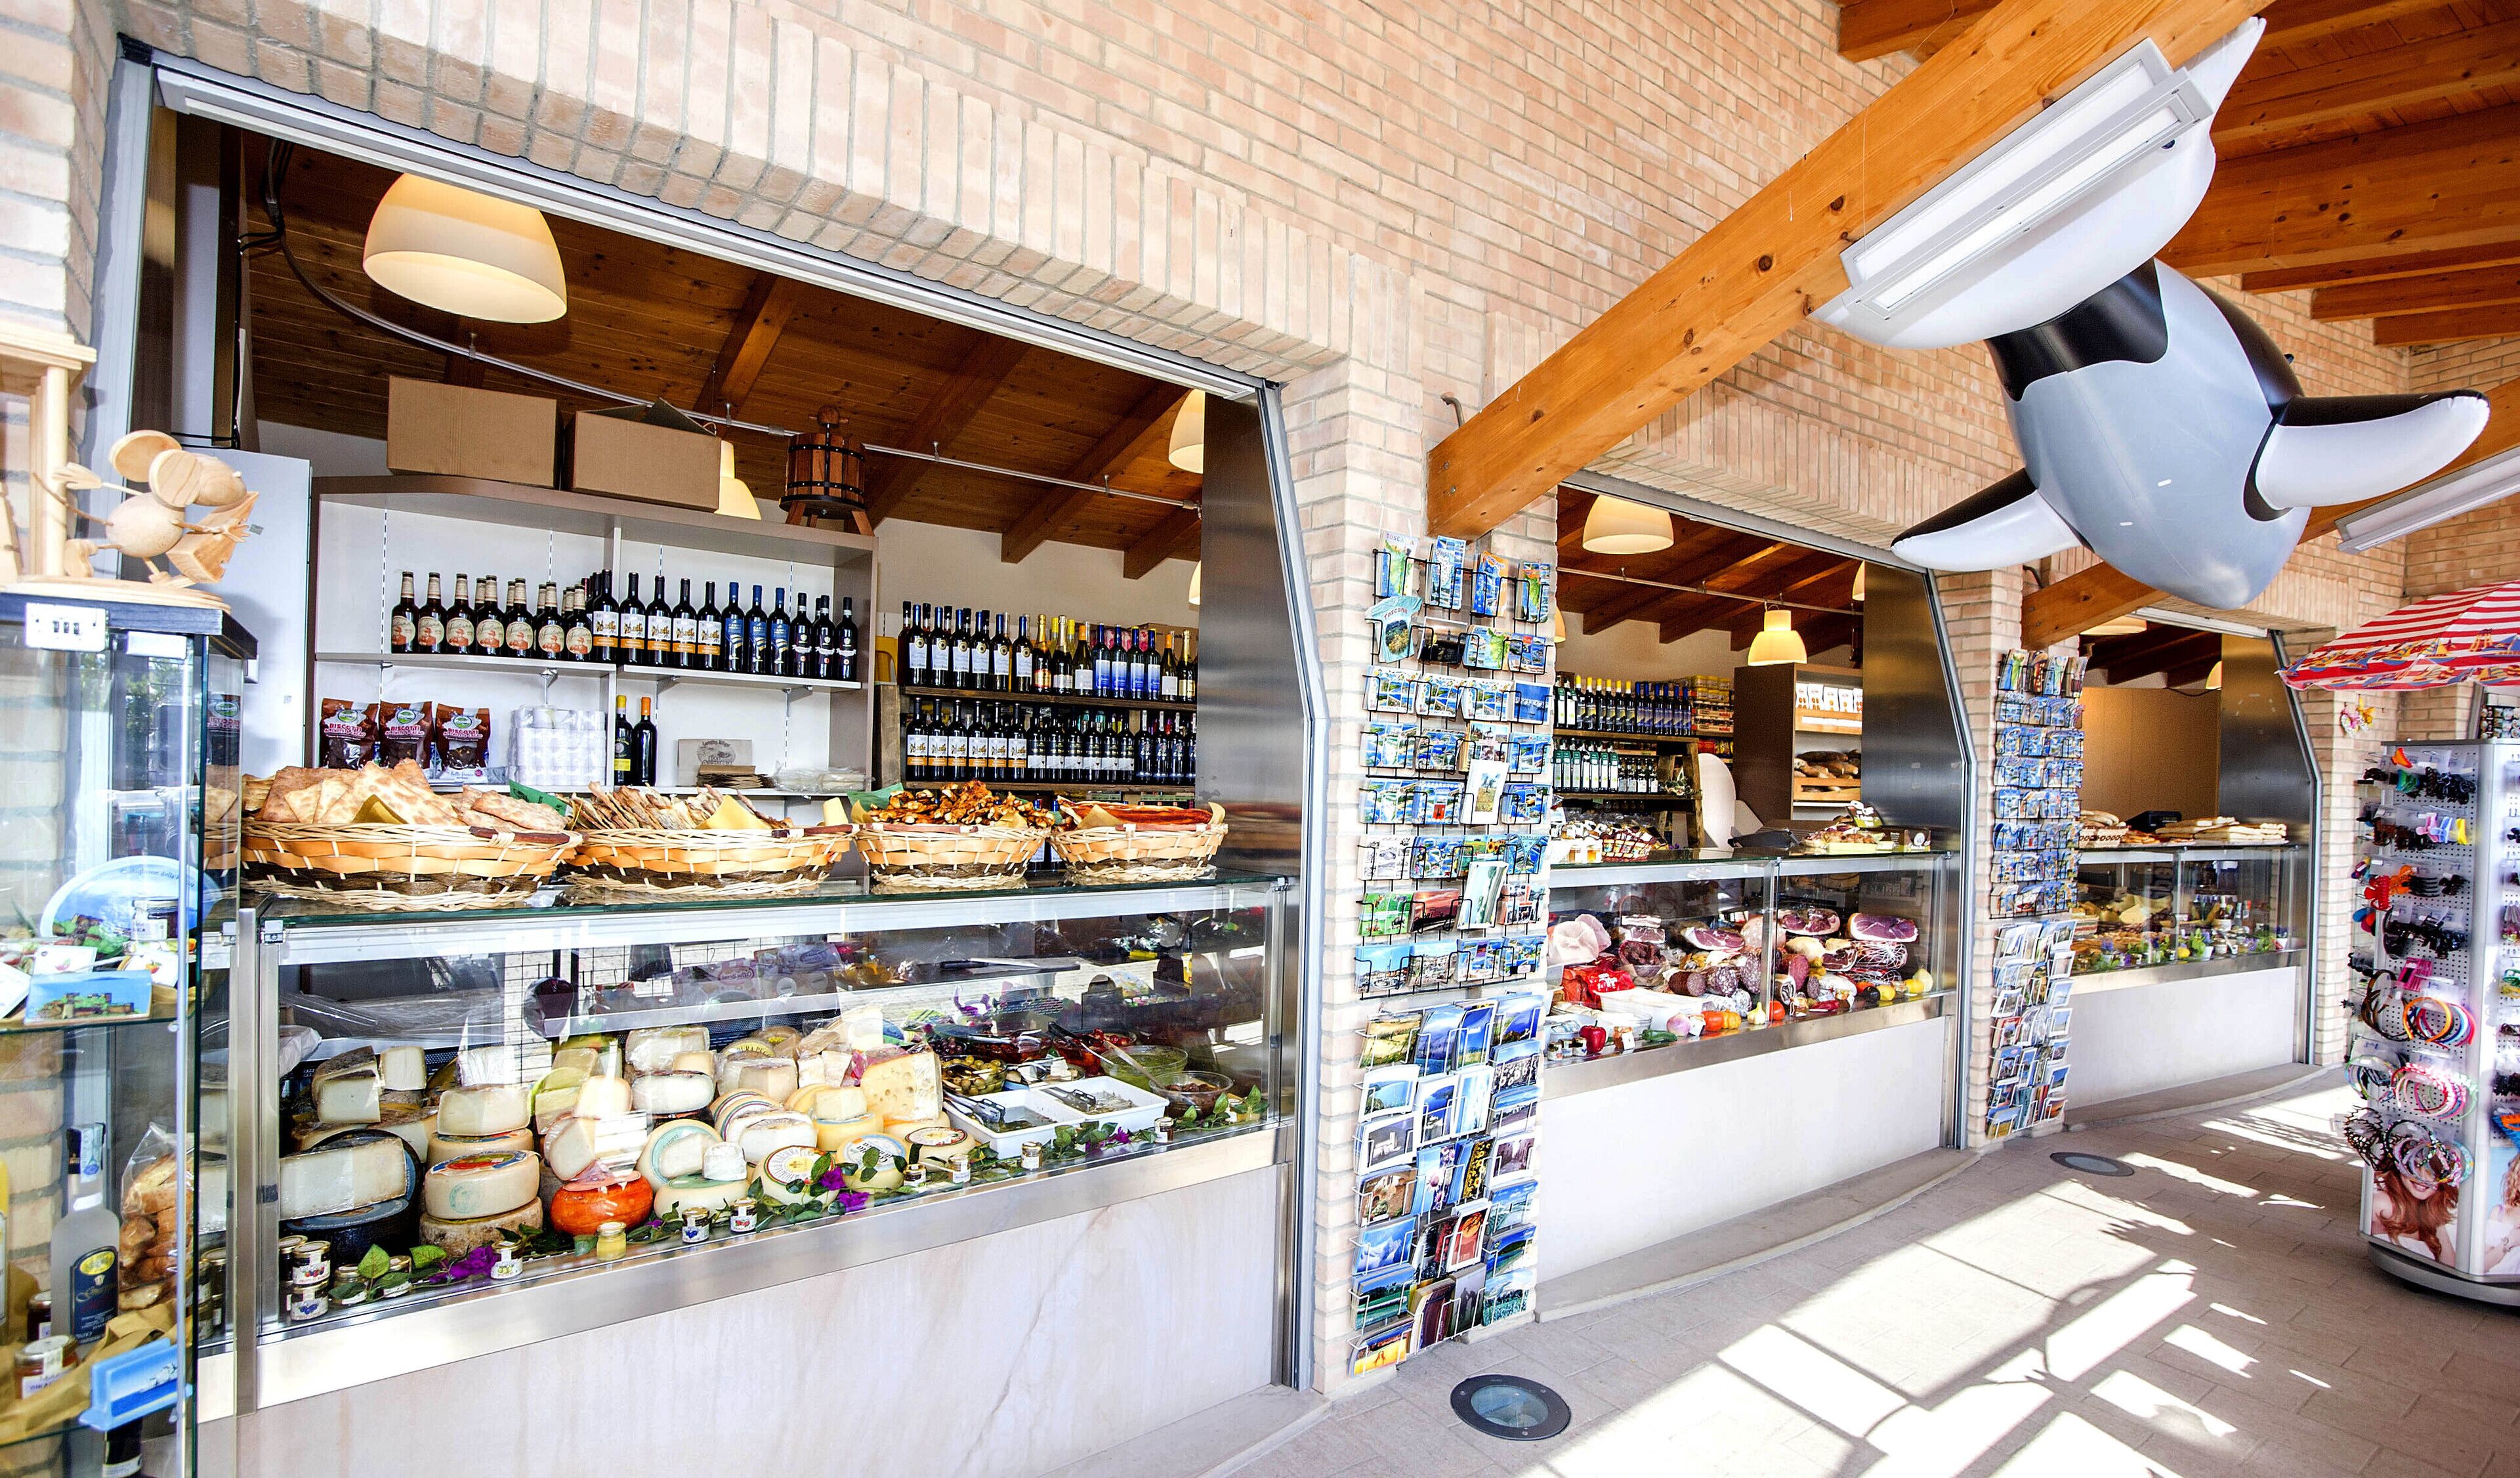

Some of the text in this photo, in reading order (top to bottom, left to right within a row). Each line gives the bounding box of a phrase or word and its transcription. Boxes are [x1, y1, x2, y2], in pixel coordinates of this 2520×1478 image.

[1385, 533, 1414, 545] TOSCAA
[1383, 607, 1408, 620] Toscana
[329, 723, 362, 732] BISCOTTI
[159, 870, 175, 879] della
